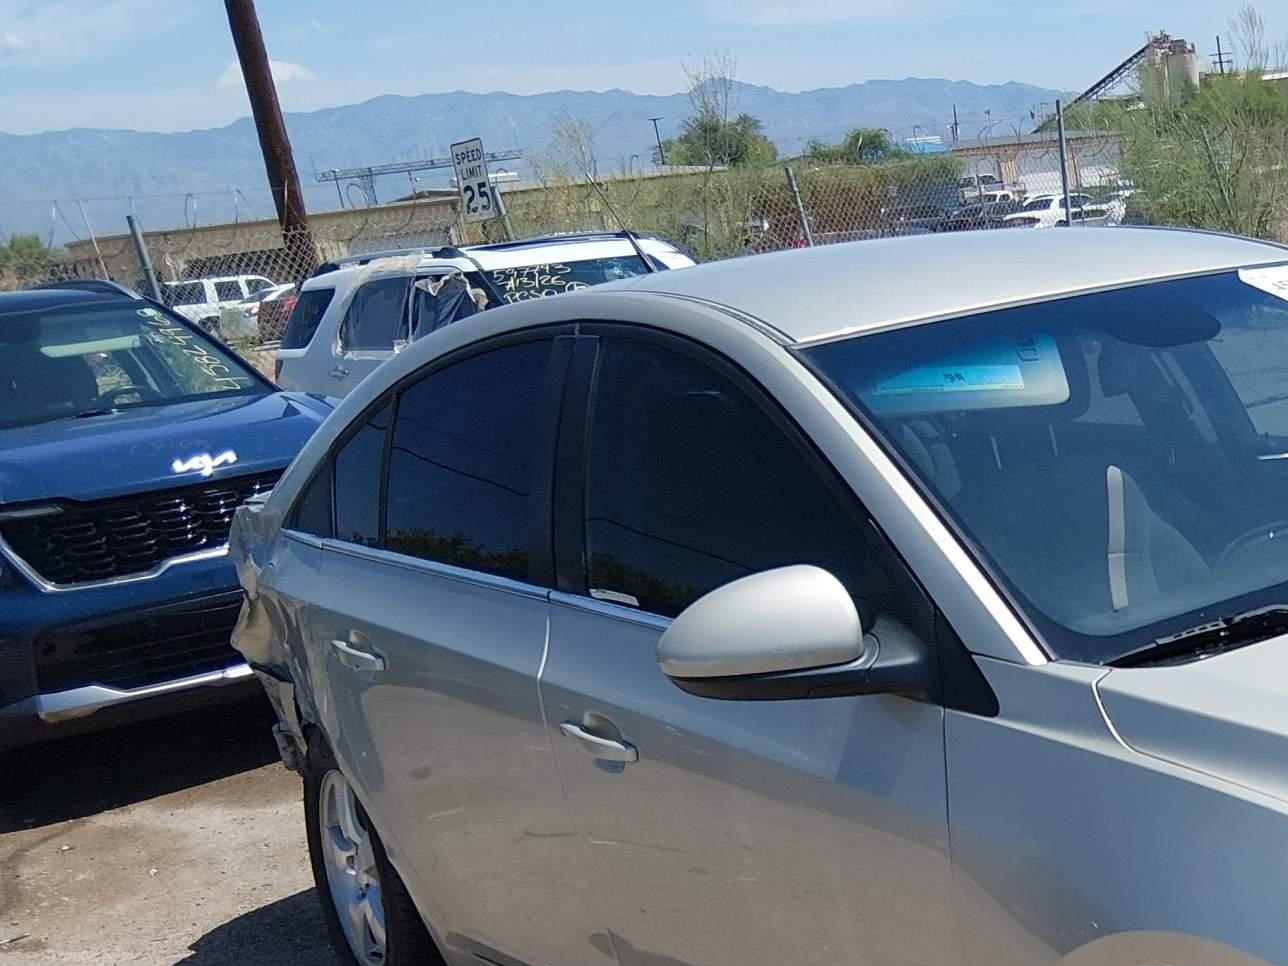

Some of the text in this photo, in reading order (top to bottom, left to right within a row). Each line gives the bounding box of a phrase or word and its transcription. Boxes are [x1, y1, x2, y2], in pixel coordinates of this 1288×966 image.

[455, 148, 482, 165] SPEED
[461, 165, 483, 181] LIMIT
[463, 181, 491, 215] 25
